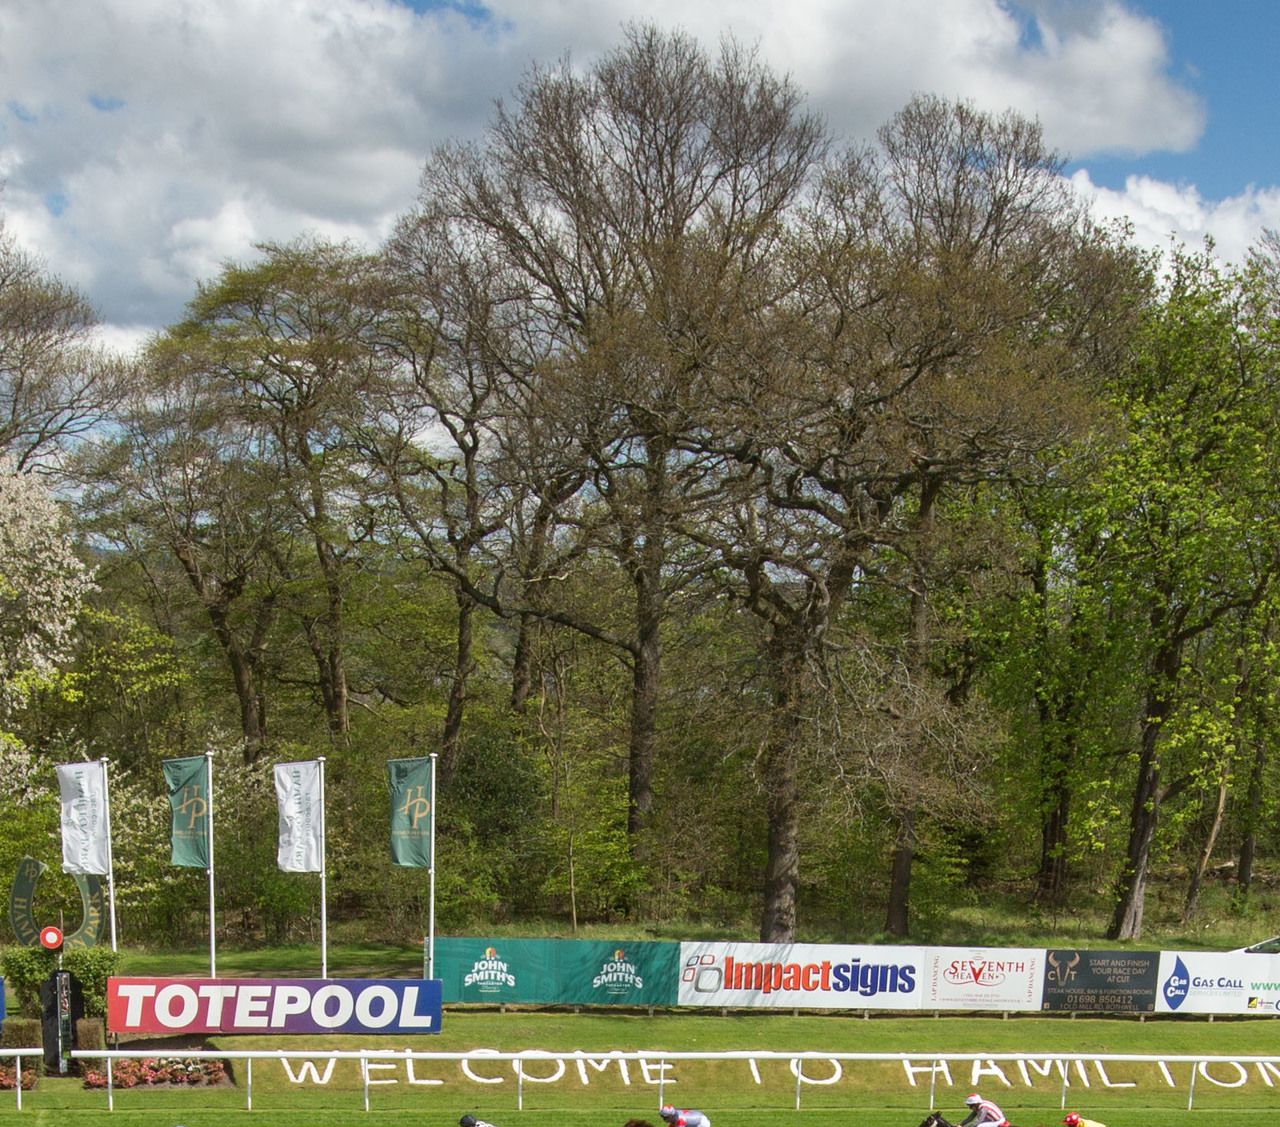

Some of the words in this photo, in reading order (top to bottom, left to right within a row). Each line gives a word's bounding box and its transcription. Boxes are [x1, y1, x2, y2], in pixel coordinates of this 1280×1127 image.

[471, 959, 508, 973] JOHN
[600, 962, 637, 975] JOHN
[1091, 967, 1112, 975] YOUR
[1127, 960, 1150, 968] FINISH
[464, 970, 516, 987] SMITH'S
[949, 960, 1025, 984] SEVENTH
[592, 972, 643, 989] SMITH'S
[117, 983, 432, 1029] TOTEPOOL
[1067, 995, 1096, 1003] 01698
[1099, 996, 1133, 1004] 850412
[277, 1048, 678, 1085] WELCOME
[726, 1050, 844, 1086] TO
